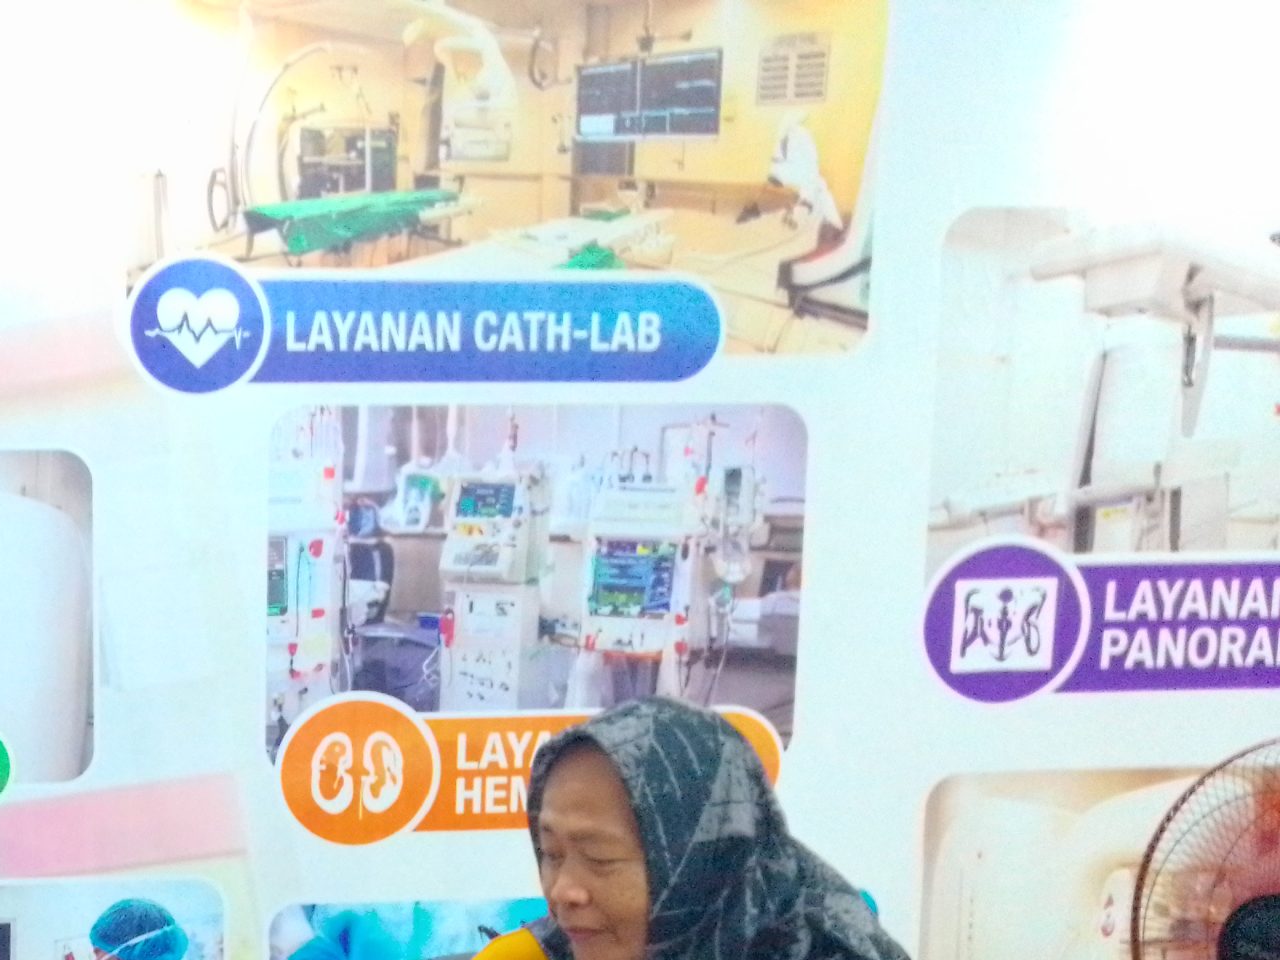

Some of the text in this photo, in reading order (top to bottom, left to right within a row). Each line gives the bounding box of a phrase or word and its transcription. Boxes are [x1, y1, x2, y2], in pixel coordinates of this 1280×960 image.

[286, 310, 662, 354] LAYANAN CATH-LAB
[1100, 626, 1280, 670] PANORA
